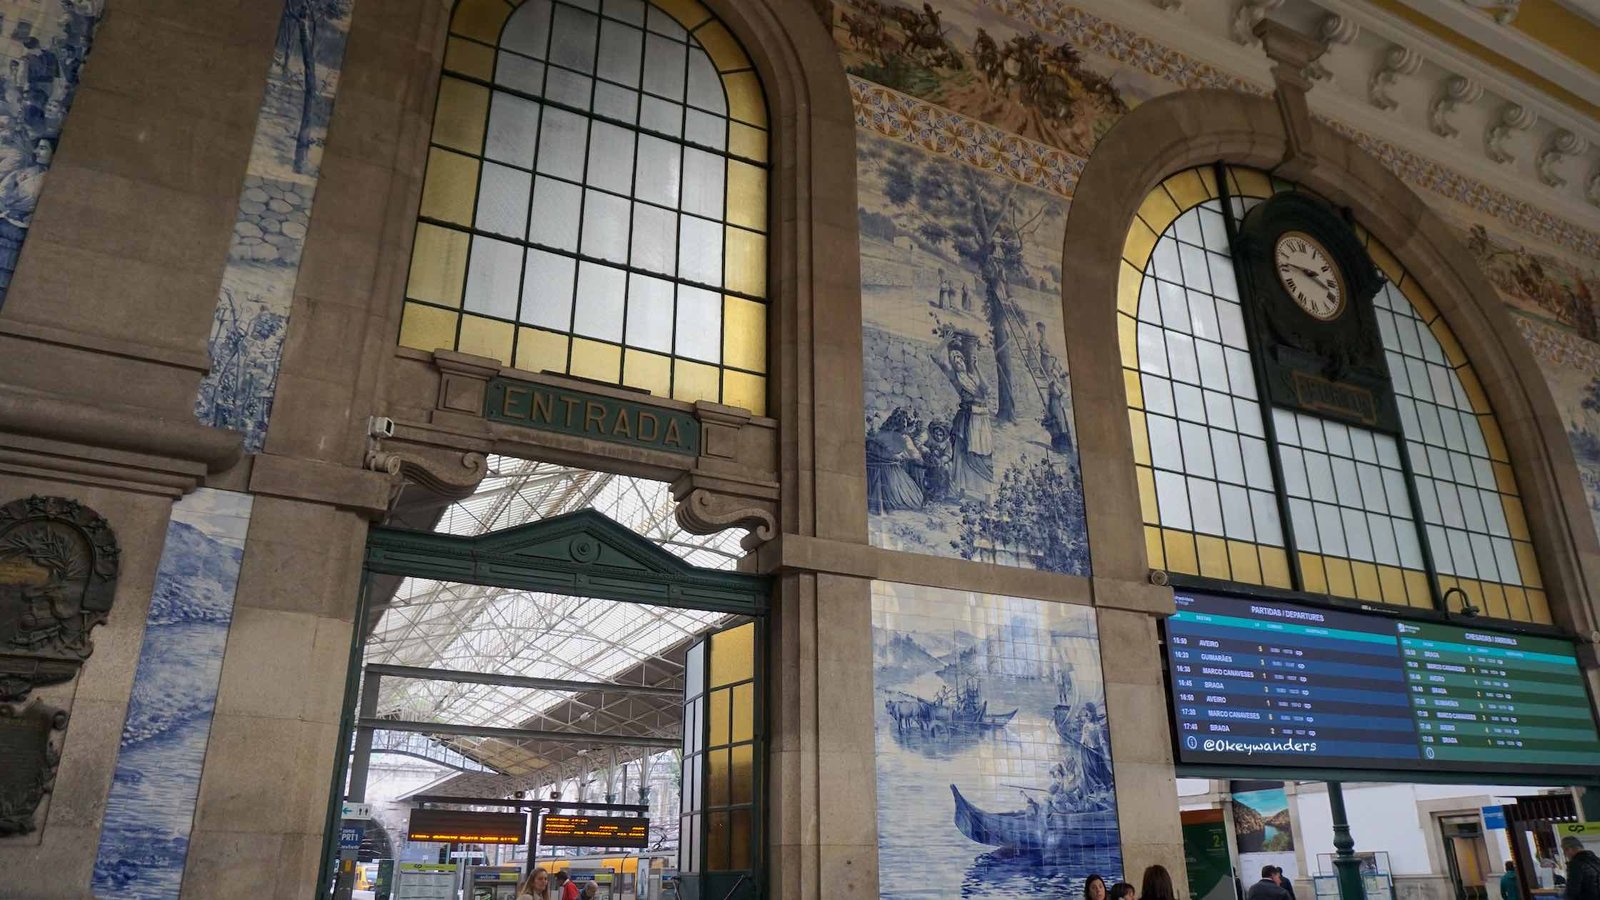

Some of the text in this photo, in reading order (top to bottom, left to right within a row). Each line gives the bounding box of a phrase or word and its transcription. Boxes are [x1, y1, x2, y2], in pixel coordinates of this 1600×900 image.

[503, 386, 682, 448] ENTRADA
[1251, 605, 1281, 617] PARTIDAS
[1285, 611, 1325, 622] DEPARTURES
[1199, 639, 1220, 648] AVEIRO
[1202, 667, 1223, 676] MARCO
[1204, 681, 1224, 690] BRAGA
[1206, 695, 1227, 704] AVEIRO
[1208, 709, 1228, 718] MARCO
[1209, 724, 1231, 732] BRAGA
[341, 833, 359, 841] PRT1
